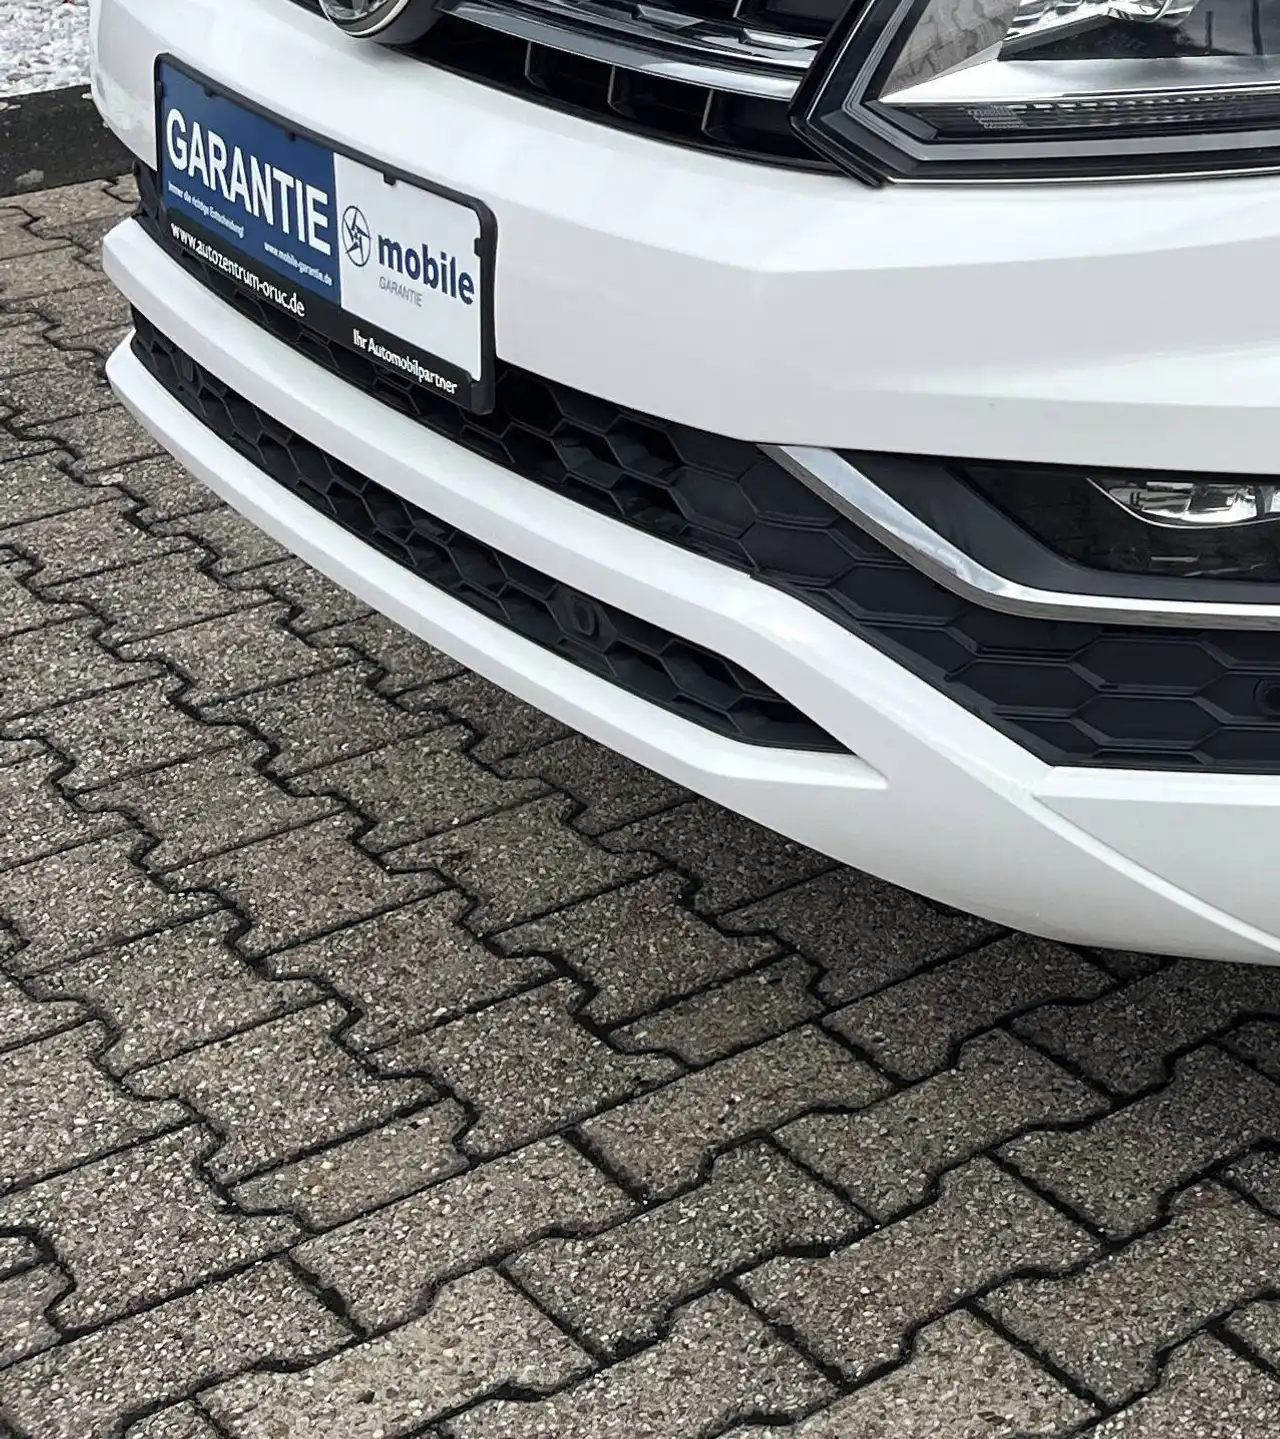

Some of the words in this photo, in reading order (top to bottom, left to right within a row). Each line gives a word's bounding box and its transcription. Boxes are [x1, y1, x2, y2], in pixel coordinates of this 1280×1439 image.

[166, 108, 332, 256] GARANTIE
[170, 222, 306, 318] www.autozentrum-oruc.de
[377, 234, 476, 306] mobile
[378, 276, 424, 308] GARANTIE
[352, 328, 367, 350] Ihr
[367, 337, 458, 395] Automobilpartner
